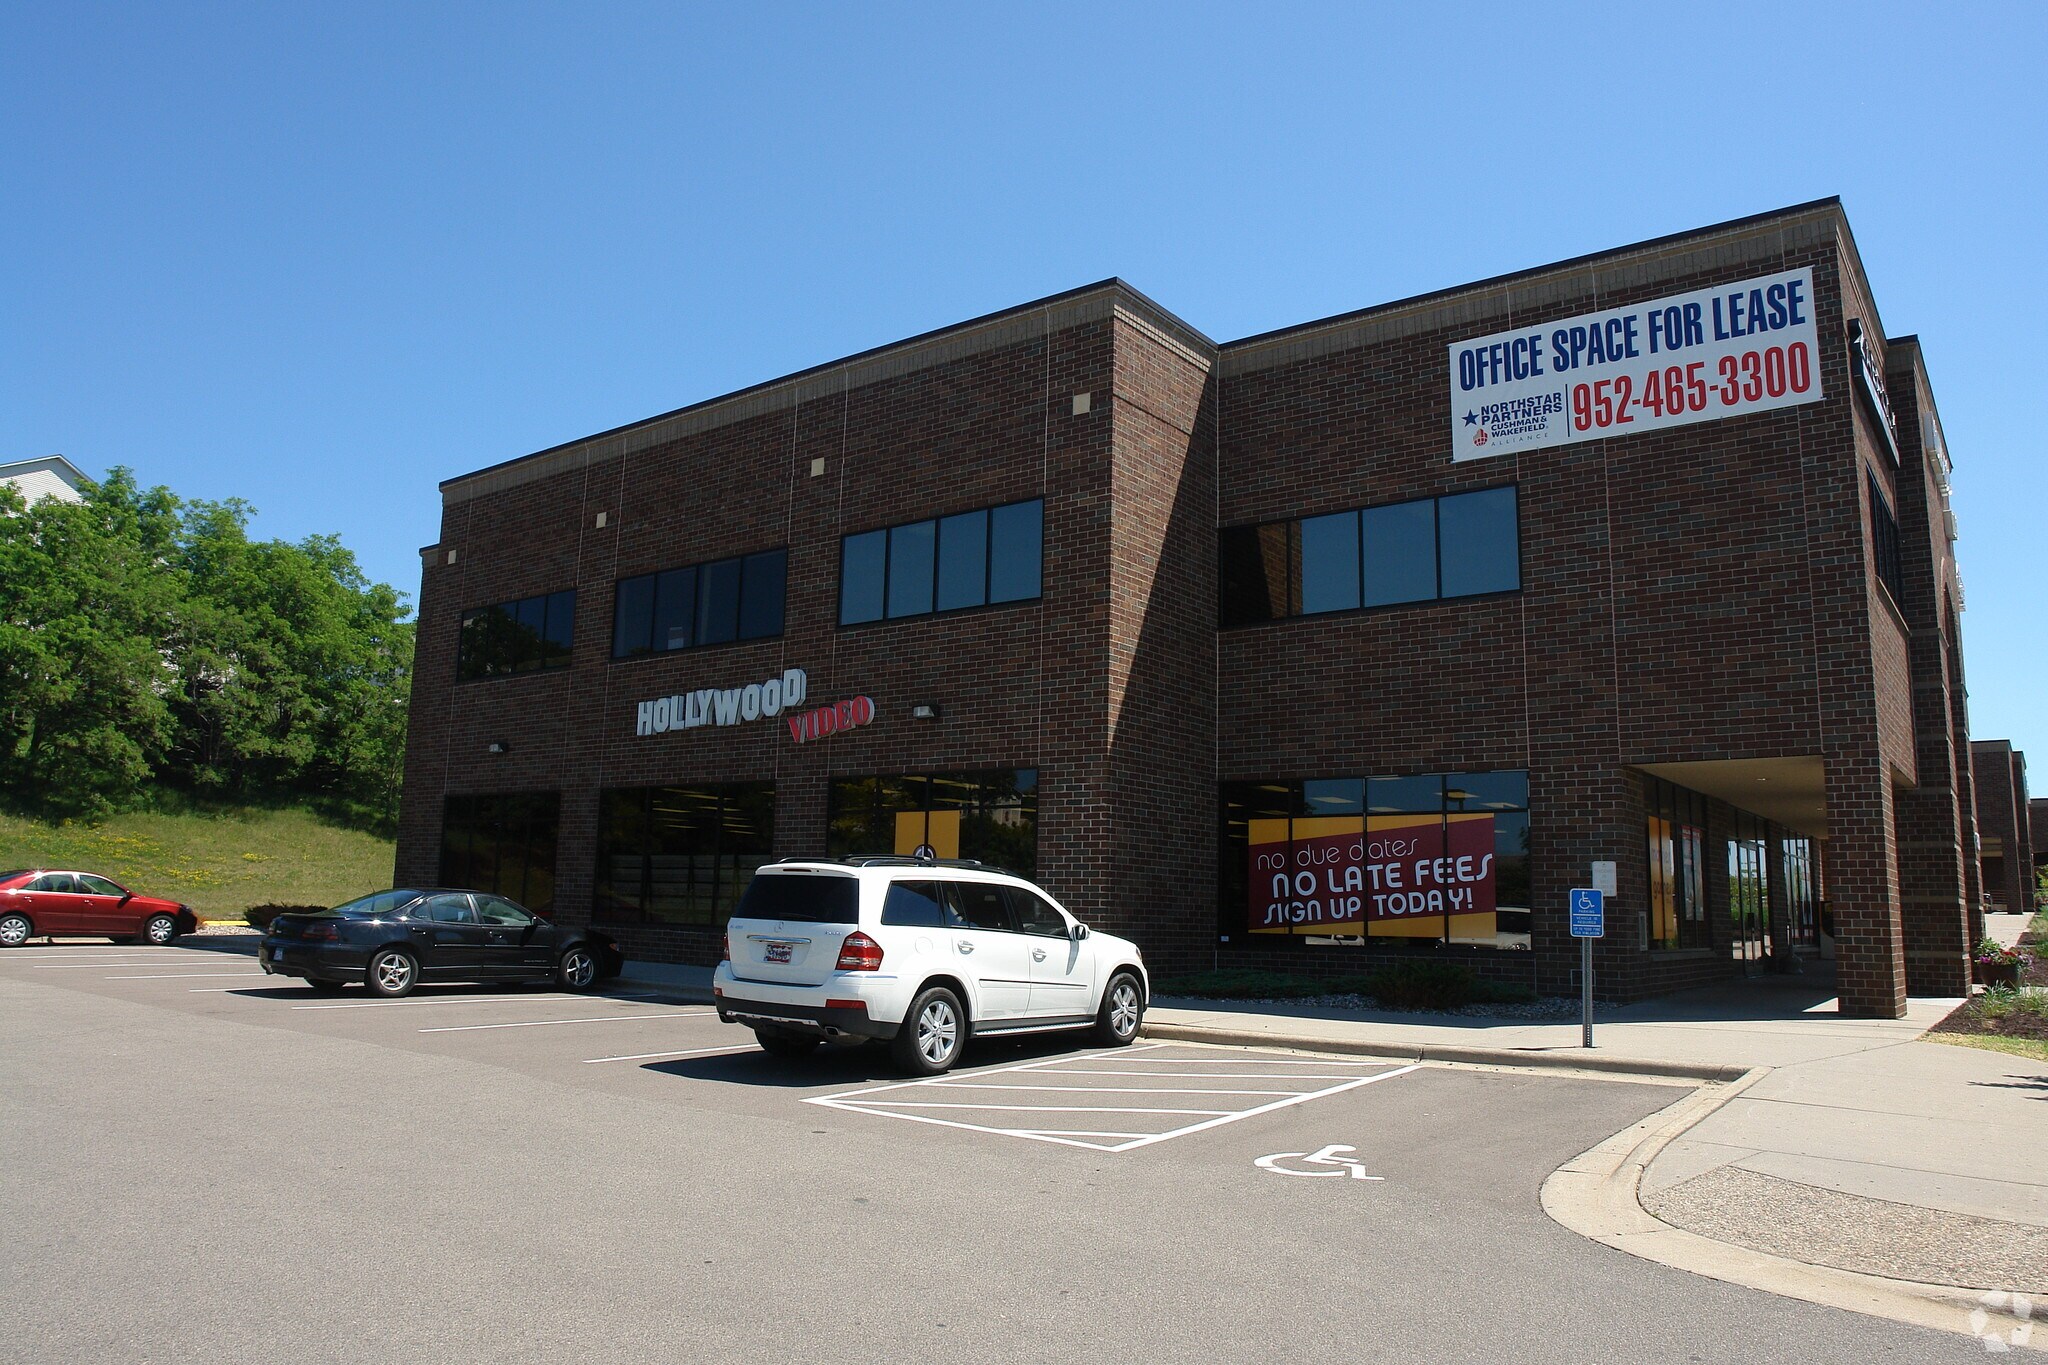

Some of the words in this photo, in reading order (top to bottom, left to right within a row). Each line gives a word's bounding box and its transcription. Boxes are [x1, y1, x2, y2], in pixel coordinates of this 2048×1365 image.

[1459, 334, 1544, 391] OFFICE
[1552, 315, 1640, 373] SPACE
[1648, 302, 1704, 354] FOR
[1712, 279, 1806, 341] LEASE
[1481, 392, 1562, 416] NORTHSTAR
[1572, 341, 1811, 431] 952-465-3300
[1481, 402, 1563, 426] PARTNERS
[1491, 417, 1539, 431] CUSHMAN
[1540, 415, 1548, 423] &
[1491, 432, 1549, 447] ALLIANCE
[636, 668, 807, 736] HOLLYWOOD
[787, 695, 875, 744] VIDEO
[1257, 852, 1285, 870] no
[1296, 843, 1341, 867] due
[1349, 837, 1418, 861] dates
[1272, 870, 1317, 899] NO
[1327, 862, 1403, 893] LATE
[1414, 853, 1493, 886] FEES
[1263, 899, 1322, 925] SIGN
[1329, 896, 1361, 919] UP
[1372, 887, 1473, 916] TODAY!
